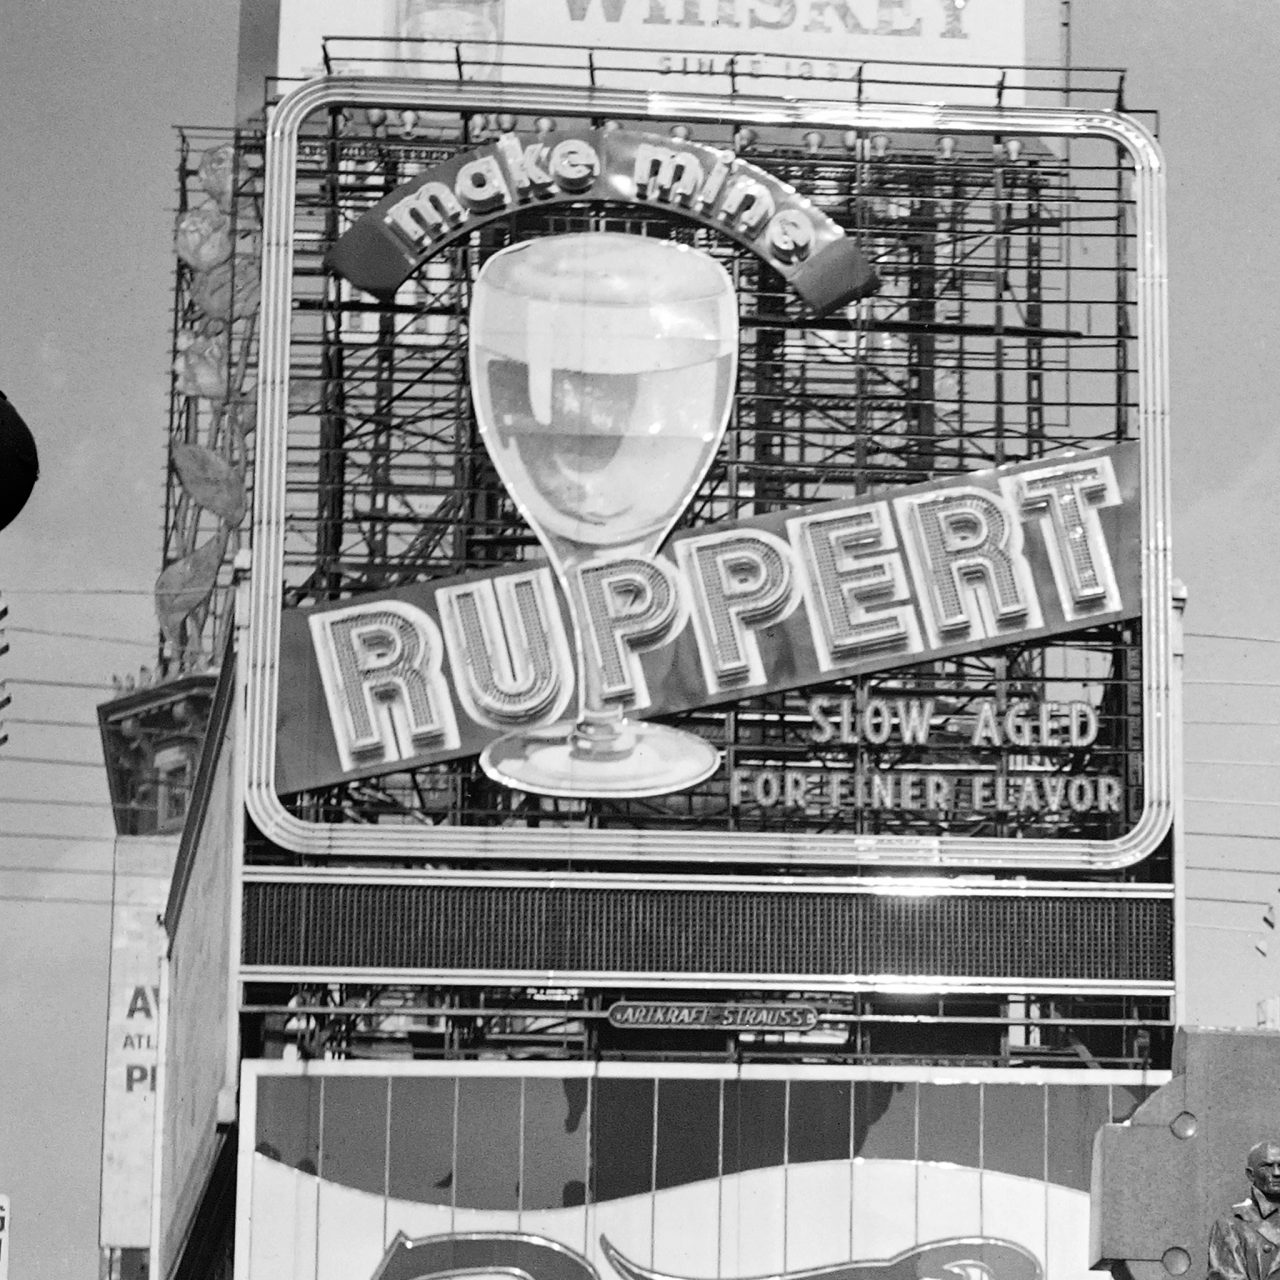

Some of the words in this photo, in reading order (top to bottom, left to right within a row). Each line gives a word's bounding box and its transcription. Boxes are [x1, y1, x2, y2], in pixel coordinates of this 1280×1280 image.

[385, 132, 600, 255] make
[633, 143, 816, 264] mine
[309, 456, 1122, 772] RUPPERT
[807, 698, 934, 745] SLOW
[972, 702, 1099, 747] AGED
[731, 770, 806, 807] FOR
[829, 771, 950, 810] FINER
[971, 774, 1123, 812] FLAVOR
[621, 1006, 710, 1024] ARTKRAFT
[723, 1007, 804, 1026] STRAUSS
[123, 1033, 156, 1050] ATL
